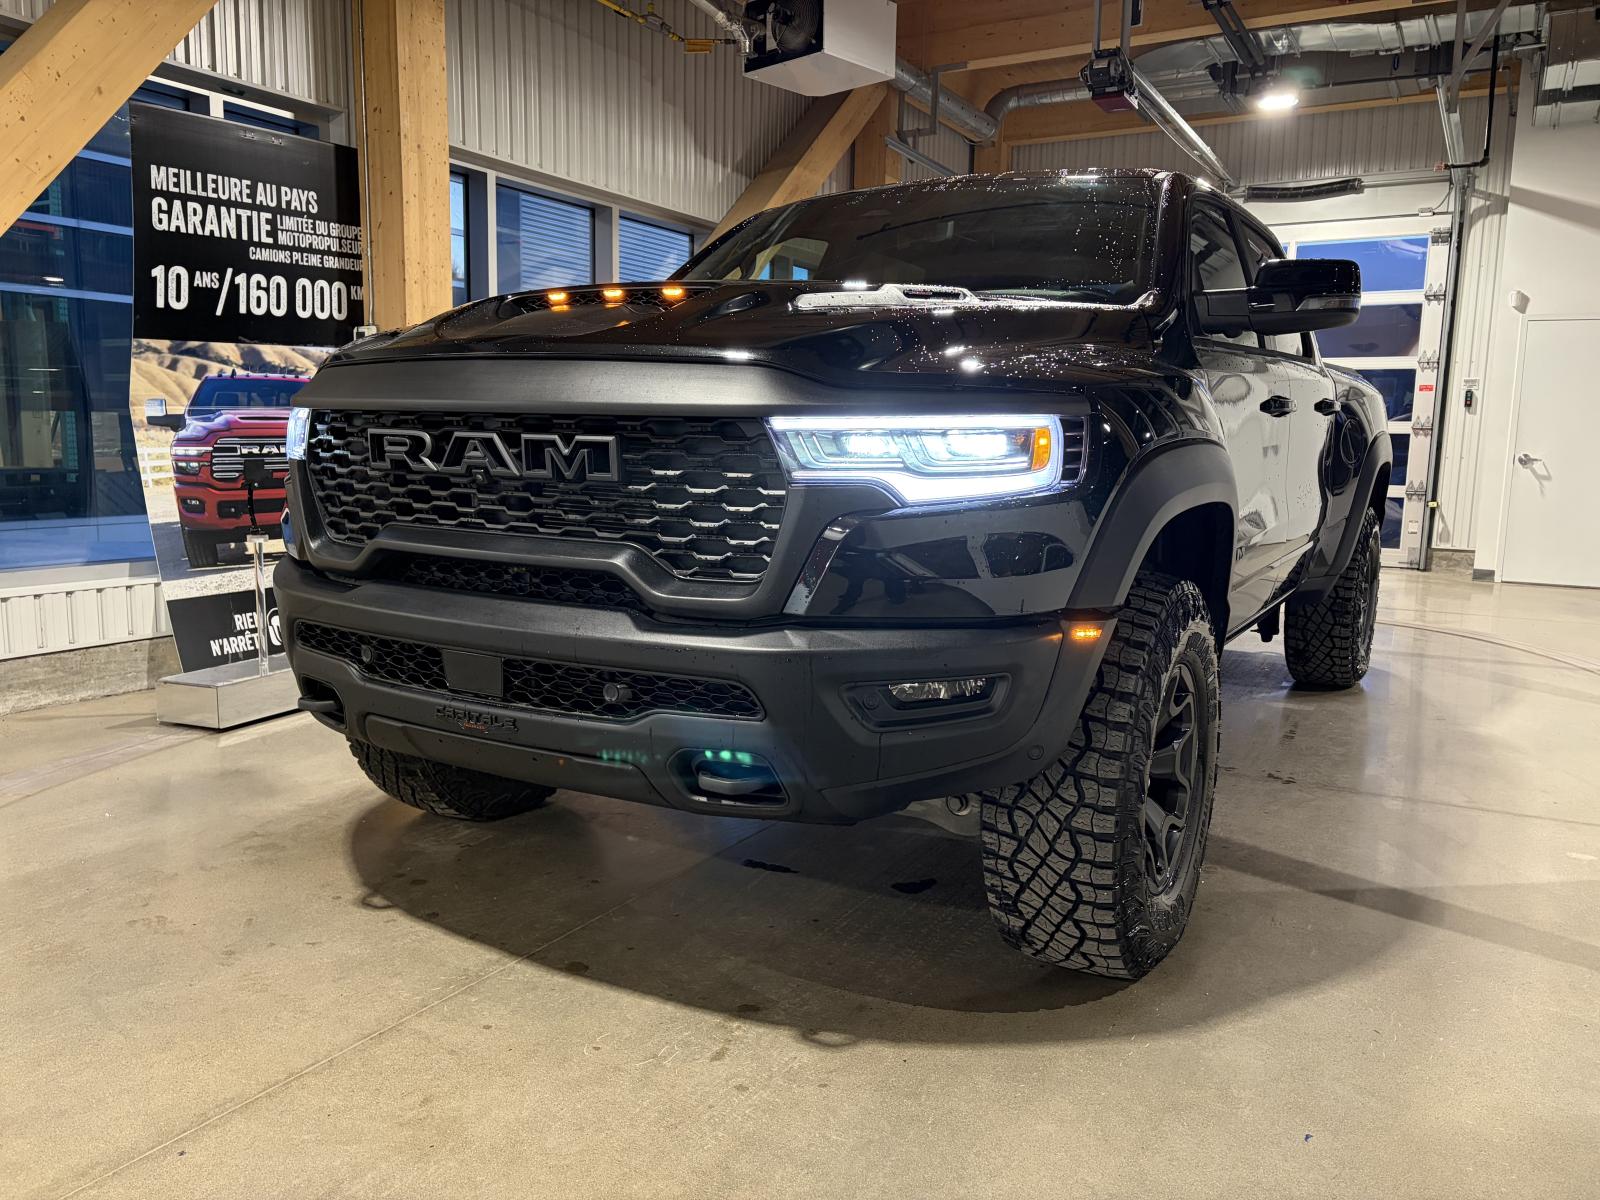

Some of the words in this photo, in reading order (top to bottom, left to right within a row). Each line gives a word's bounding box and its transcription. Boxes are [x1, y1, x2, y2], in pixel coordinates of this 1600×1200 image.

[150, 164, 251, 204] MEILLEURE
[256, 182, 277, 208] AU
[281, 186, 318, 214] PAYS
[151, 197, 274, 244] GARANTIE
[277, 214, 314, 234] LIMITÉE
[316, 220, 328, 236] DU
[330, 222, 362, 240] GROUPE
[249, 246, 291, 264] CAMIONS
[292, 251, 323, 267] PLEINE
[151, 264, 189, 310] 10
[295, 277, 348, 321] 000
[367, 428, 621, 482] RAM
